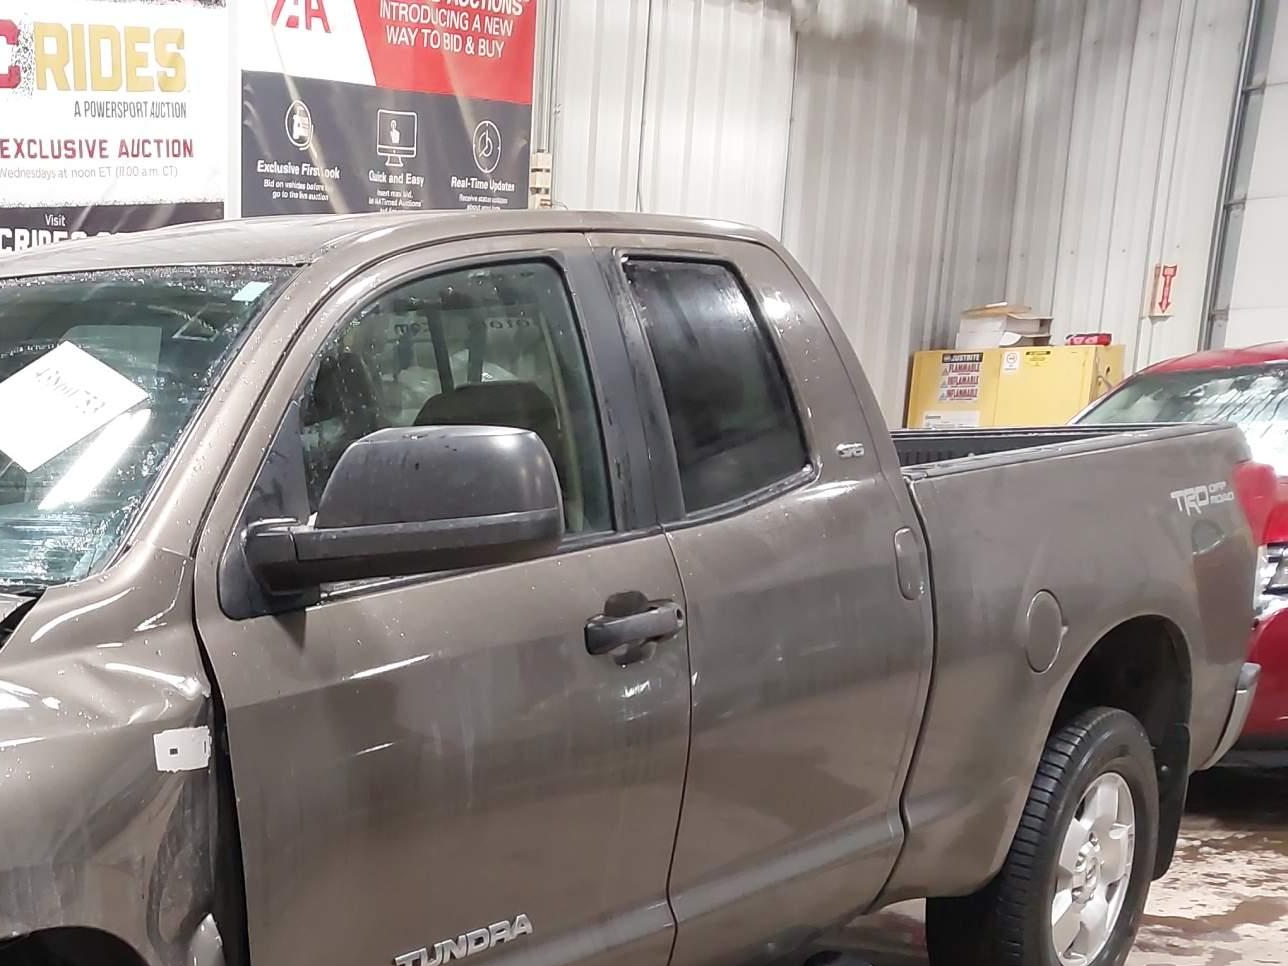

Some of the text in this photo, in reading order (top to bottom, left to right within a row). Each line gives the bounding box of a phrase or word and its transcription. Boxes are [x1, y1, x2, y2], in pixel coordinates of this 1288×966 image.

[379, 0, 513, 37] INTRODUCING A NEW
[386, 25, 505, 58] WAY TO BID & BUY
[74, 100, 188, 119] A POWERSPORT AUCTION
[117, 138, 194, 158] AUCTION
[58, 168, 68, 178] at
[71, 168, 96, 178] noon
[98, 166, 112, 178] ET
[162, 165, 179, 178] CT)
[256, 160, 300, 176] Exclusive
[321, 167, 341, 180] ook
[368, 169, 425, 188] Quick and Easy
[263, 179, 275, 188] Bid
[451, 176, 516, 193] Real-Time Updates
[272, 191, 281, 200] go
[281, 190, 289, 199] to
[45, 213, 66, 227] Visit
[1208, 481, 1227, 492] OFF
[1170, 485, 1210, 516] TRD
[1210, 491, 1235, 504] ROAD
